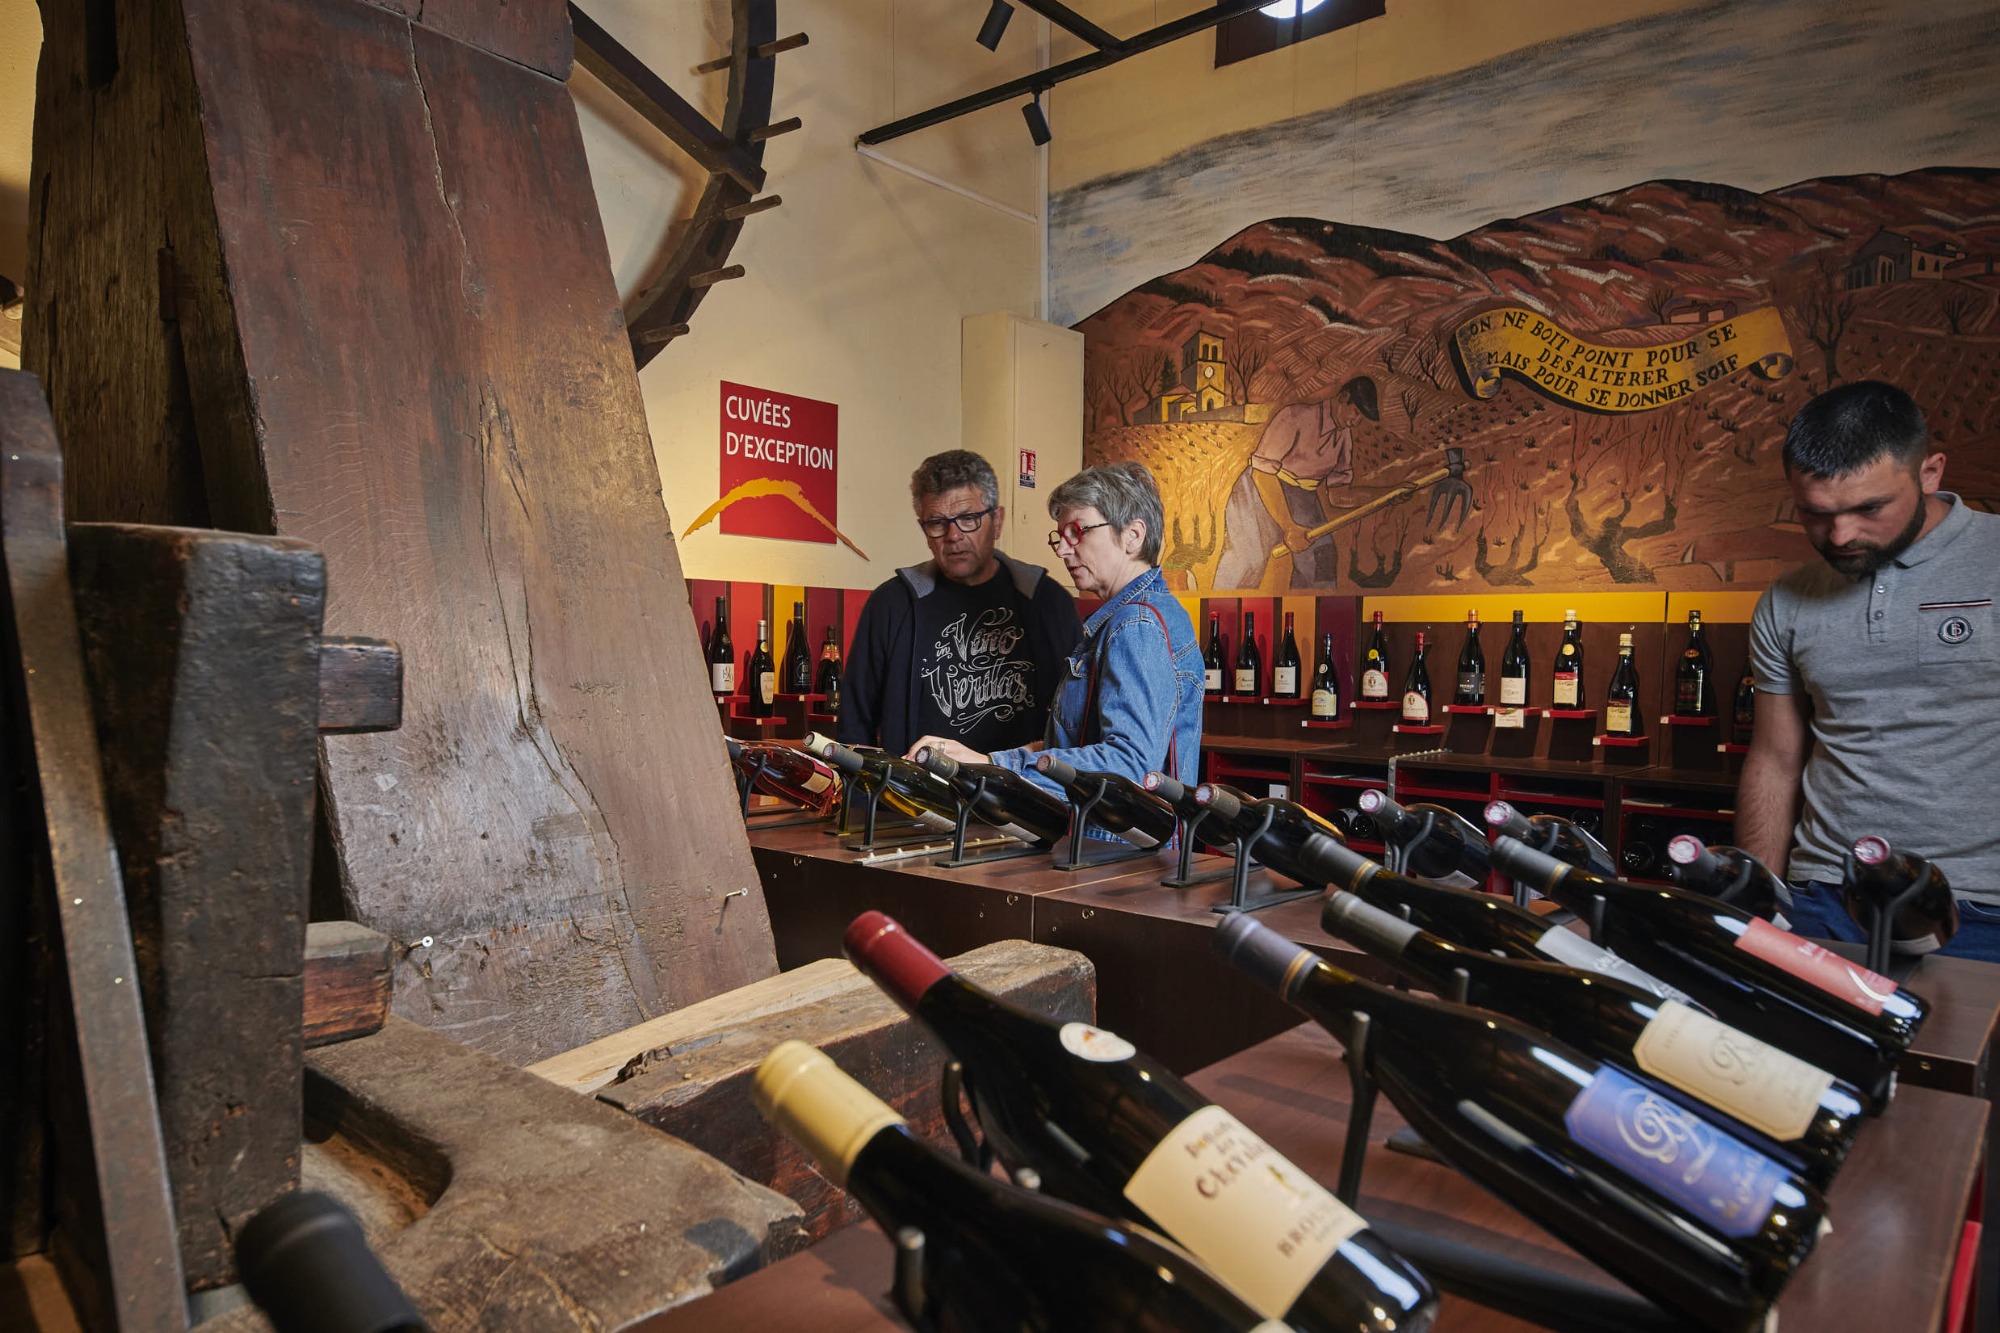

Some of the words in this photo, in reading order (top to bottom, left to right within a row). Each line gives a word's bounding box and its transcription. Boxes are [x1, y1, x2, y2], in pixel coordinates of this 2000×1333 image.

[1469, 316, 1492, 336] ON
[1502, 311, 1529, 330] NE
[1530, 320, 1570, 351] BOIT
[1571, 344, 1634, 368] POINT
[1646, 341, 1701, 367] POUR
[1707, 323, 1737, 348] SE
[1486, 351, 1531, 370] MAIS
[1533, 366, 1579, 398] POUR
[1585, 388, 1611, 407] SE
[1615, 379, 1695, 408] DONNER
[1695, 353, 1738, 387] SOIF
[1537, 347, 1669, 387] DESALTERER
[725, 395, 791, 429] CUVÉES
[726, 431, 833, 471] D'EXCEPTION
